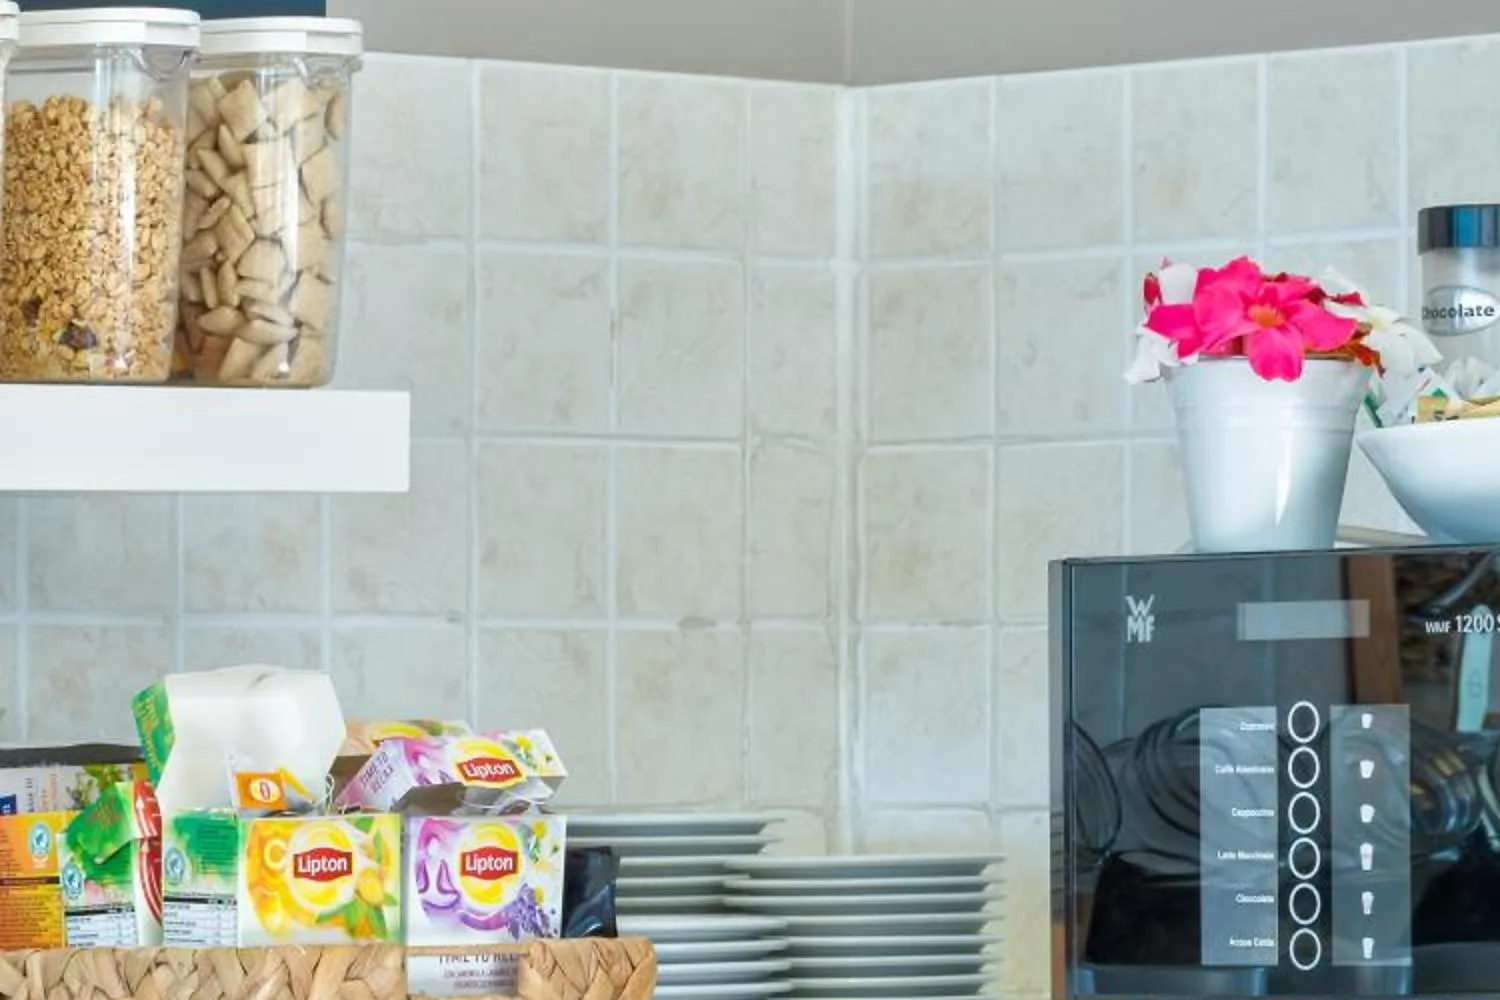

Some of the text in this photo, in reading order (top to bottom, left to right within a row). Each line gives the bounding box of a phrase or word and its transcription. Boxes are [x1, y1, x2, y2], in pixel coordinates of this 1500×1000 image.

[1425, 620, 1451, 633] WMF
[1456, 613, 1495, 633] 1200
[463, 761, 515, 779] Lipton
[297, 855, 348, 875] Lipton
[464, 854, 514, 874] Lipton
